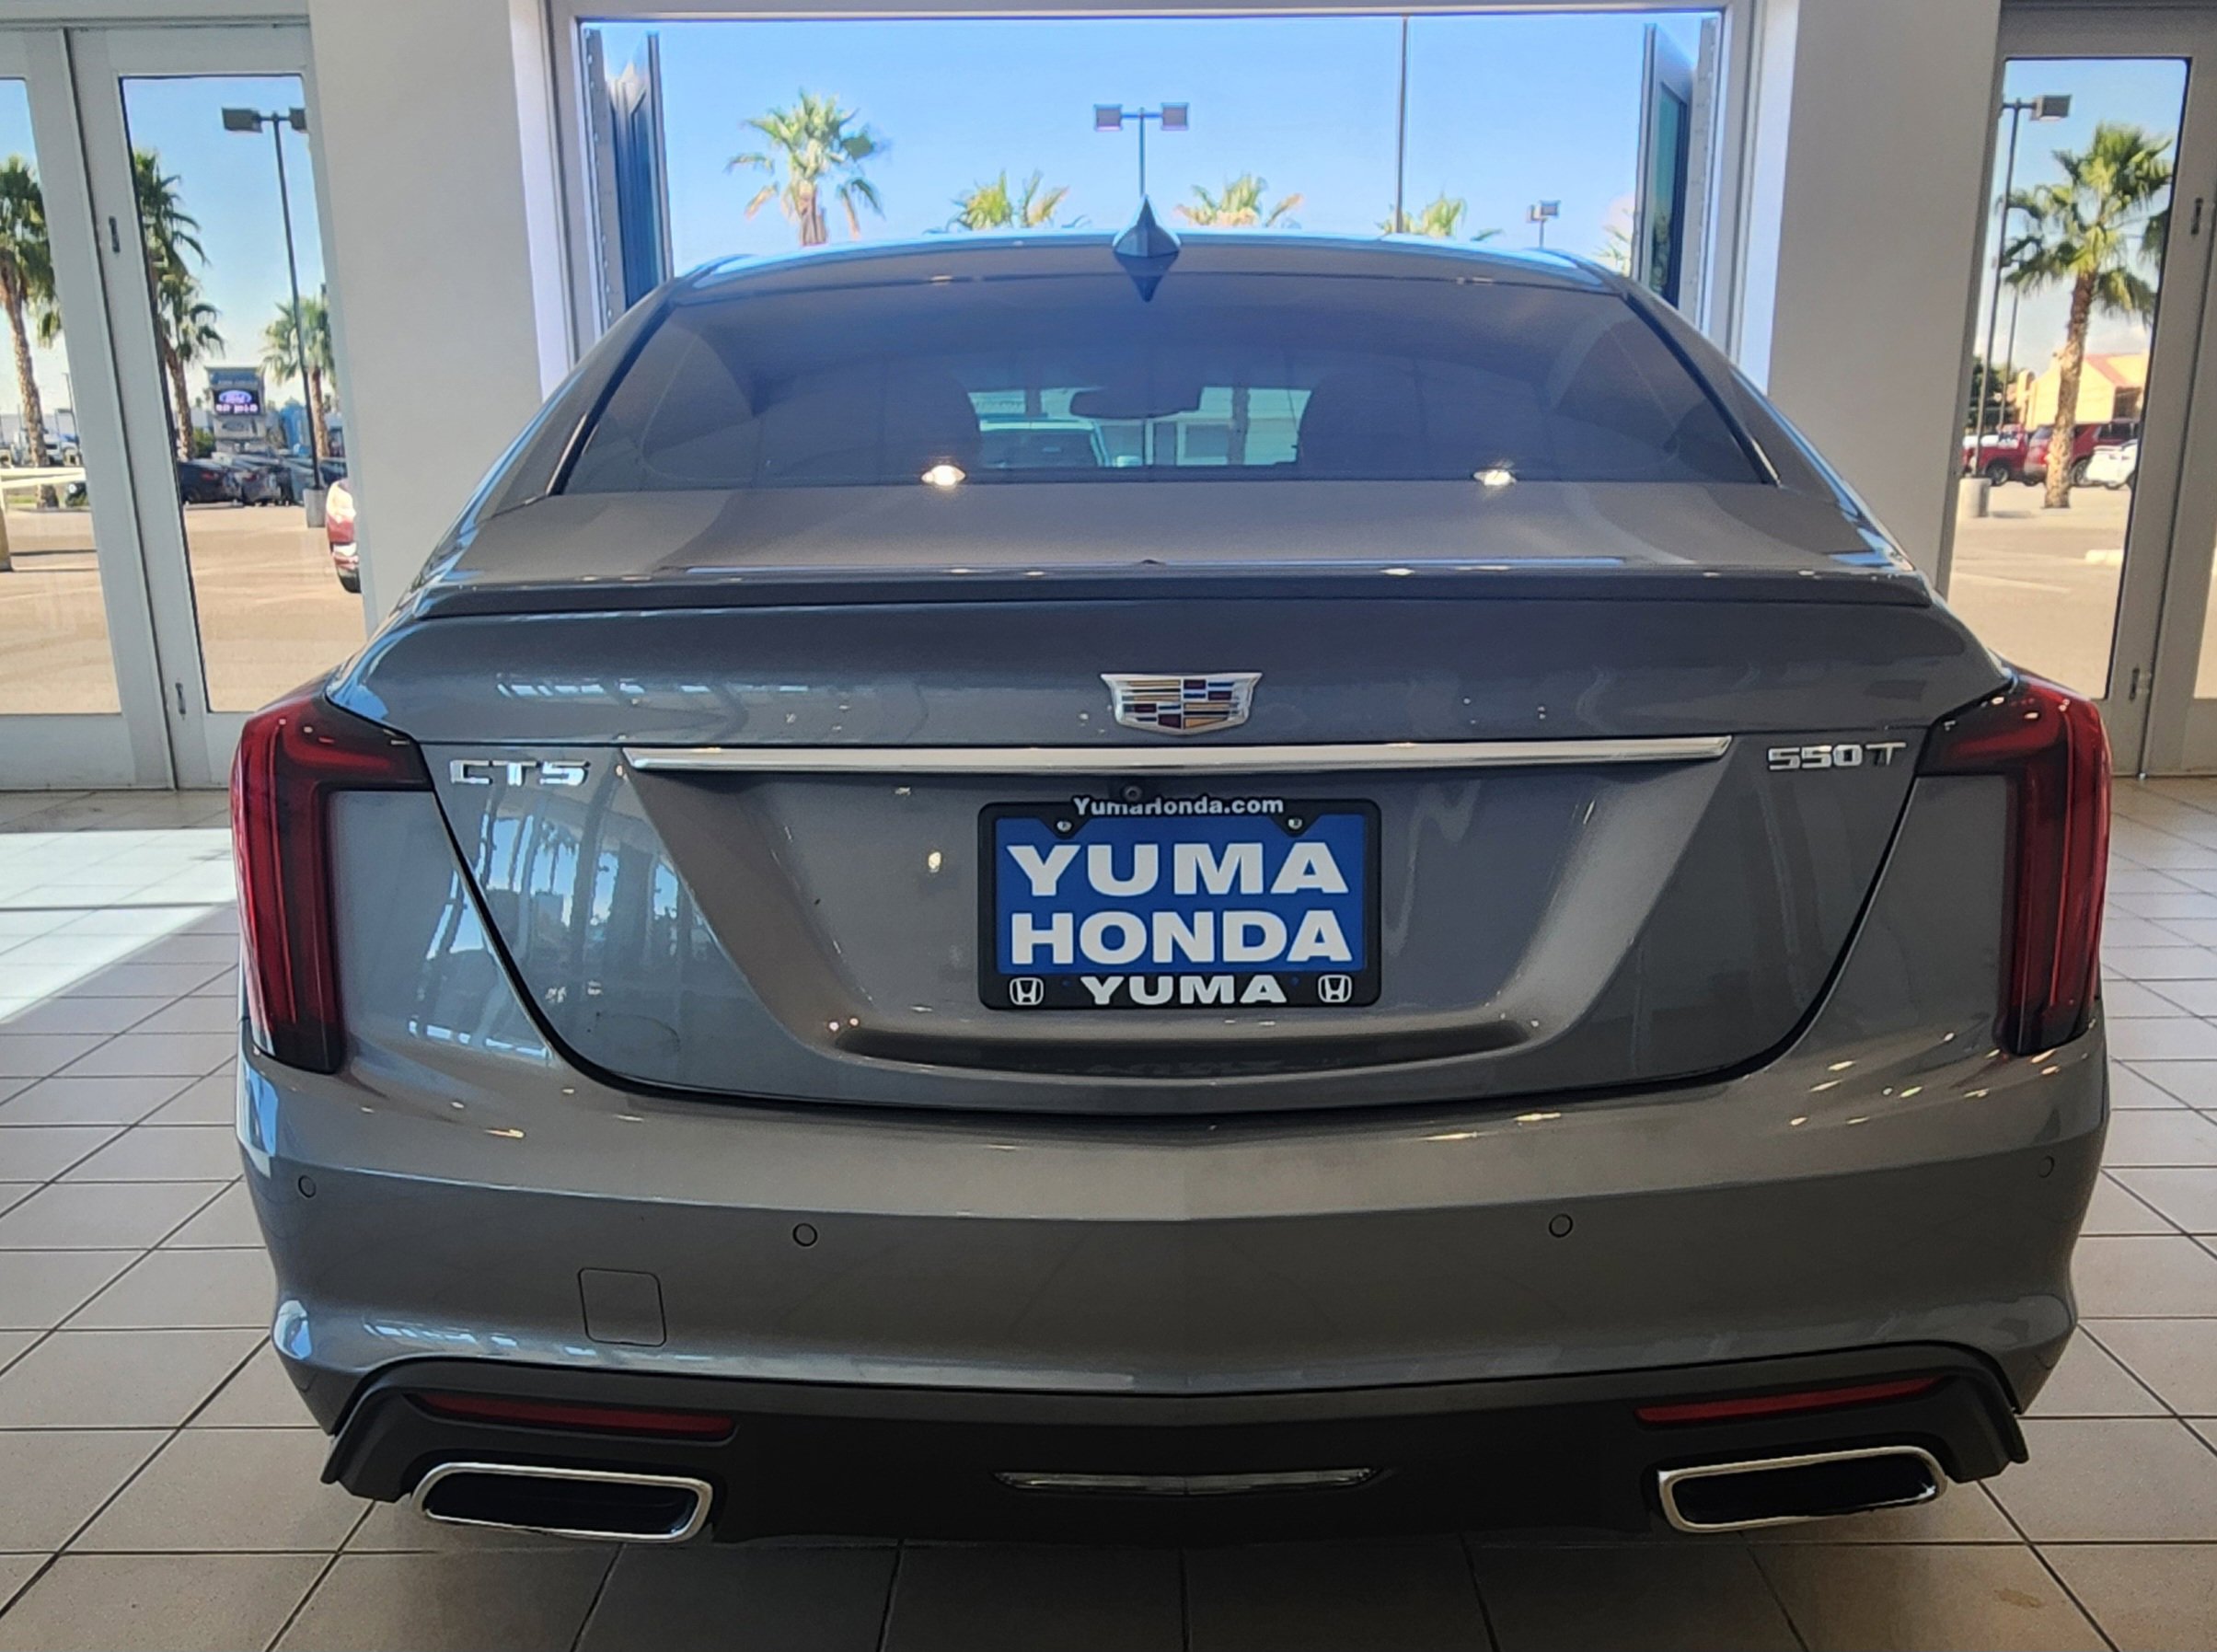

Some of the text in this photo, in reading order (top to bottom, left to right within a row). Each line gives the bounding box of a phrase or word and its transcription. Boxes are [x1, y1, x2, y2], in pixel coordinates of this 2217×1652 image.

[1006, 842, 1349, 896] YUMA
[1011, 909, 1353, 965] HONDA
[1080, 976, 1287, 1004] YUMA
